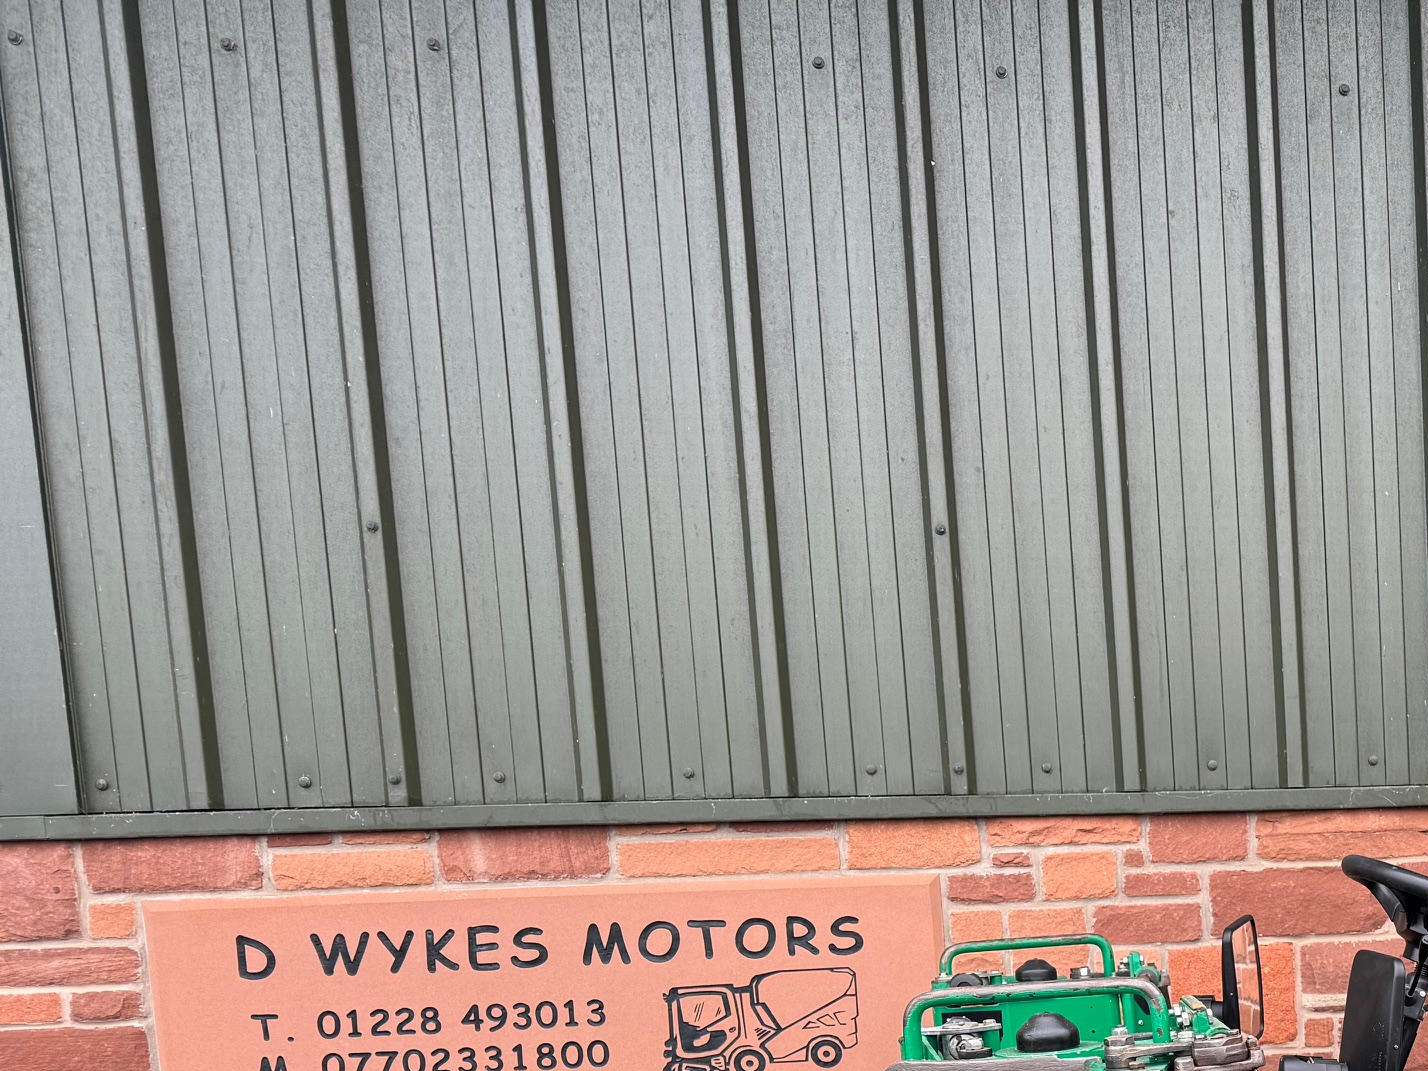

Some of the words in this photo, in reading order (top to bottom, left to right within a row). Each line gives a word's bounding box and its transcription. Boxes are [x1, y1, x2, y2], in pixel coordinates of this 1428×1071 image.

[235, 934, 276, 981] D
[309, 924, 549, 977] WYKES
[582, 915, 864, 966] MOTORS
[250, 1013, 295, 1043] T.
[316, 1005, 442, 1040] 01228
[460, 998, 606, 1033] 493013
